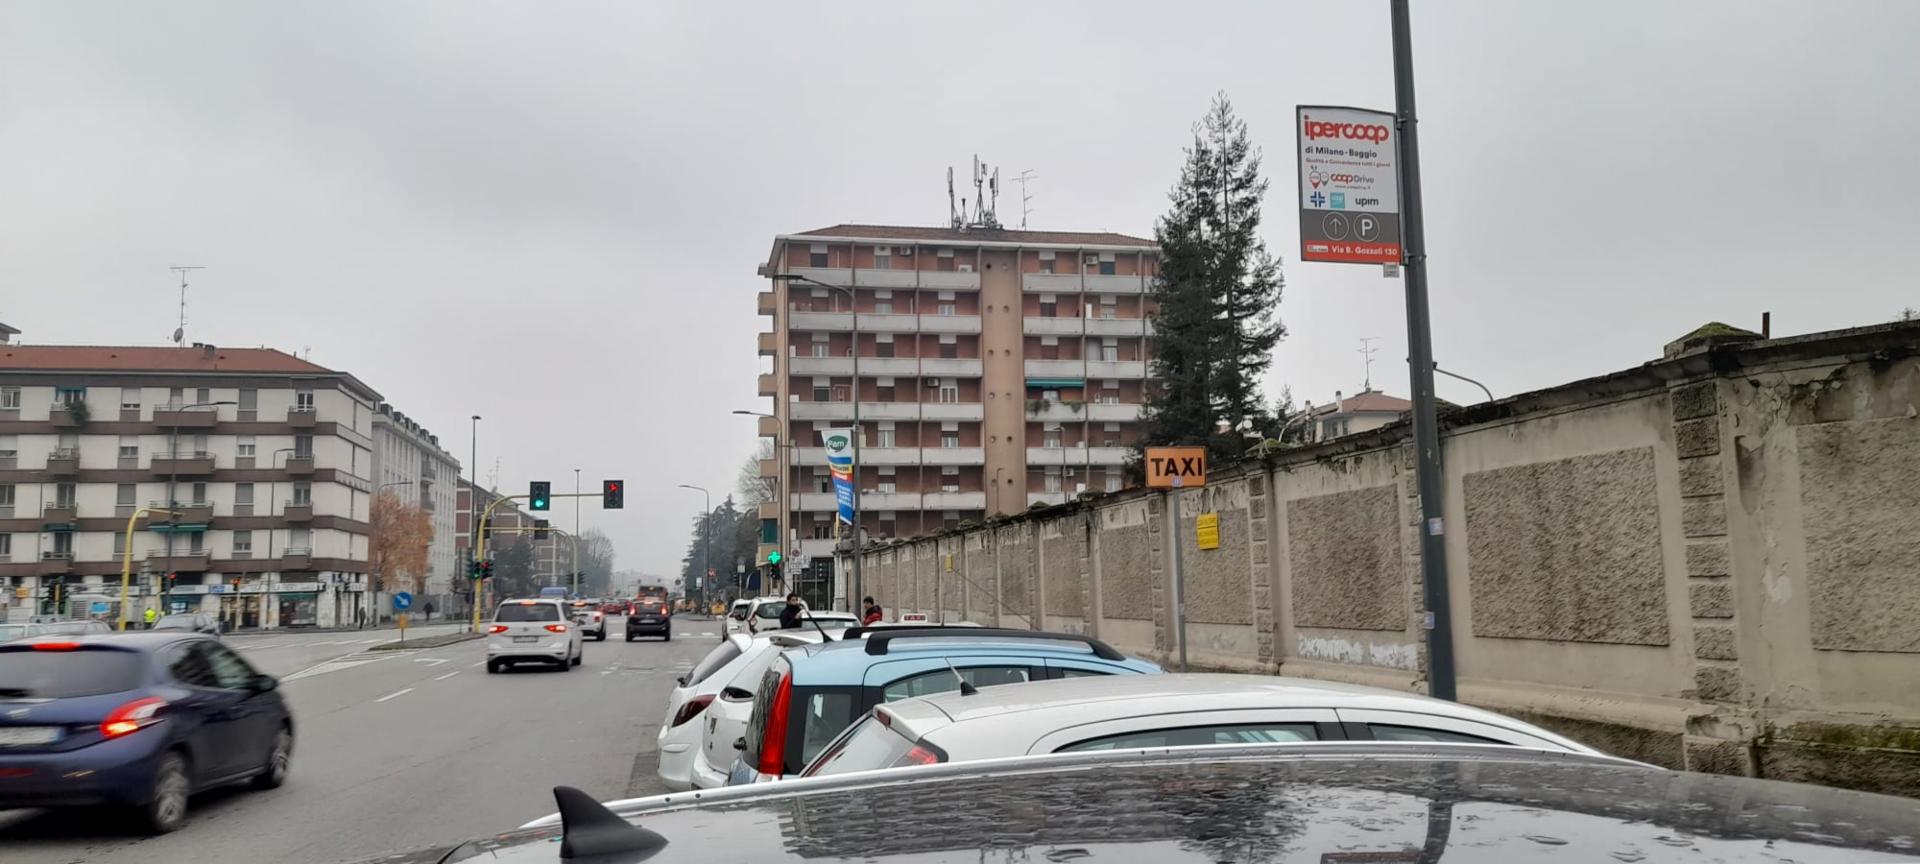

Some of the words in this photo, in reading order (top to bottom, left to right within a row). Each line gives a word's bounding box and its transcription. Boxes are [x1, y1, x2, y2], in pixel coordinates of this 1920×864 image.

[1304, 115, 1389, 145] ipercoop
[1305, 146, 1313, 154] di
[1355, 197, 1379, 208] upim
[1361, 219, 1373, 237] P
[1331, 245, 1344, 254] Via
[1384, 247, 1398, 256] 130
[827, 440, 845, 448] Pam
[1150, 457, 1203, 477] TAXI
